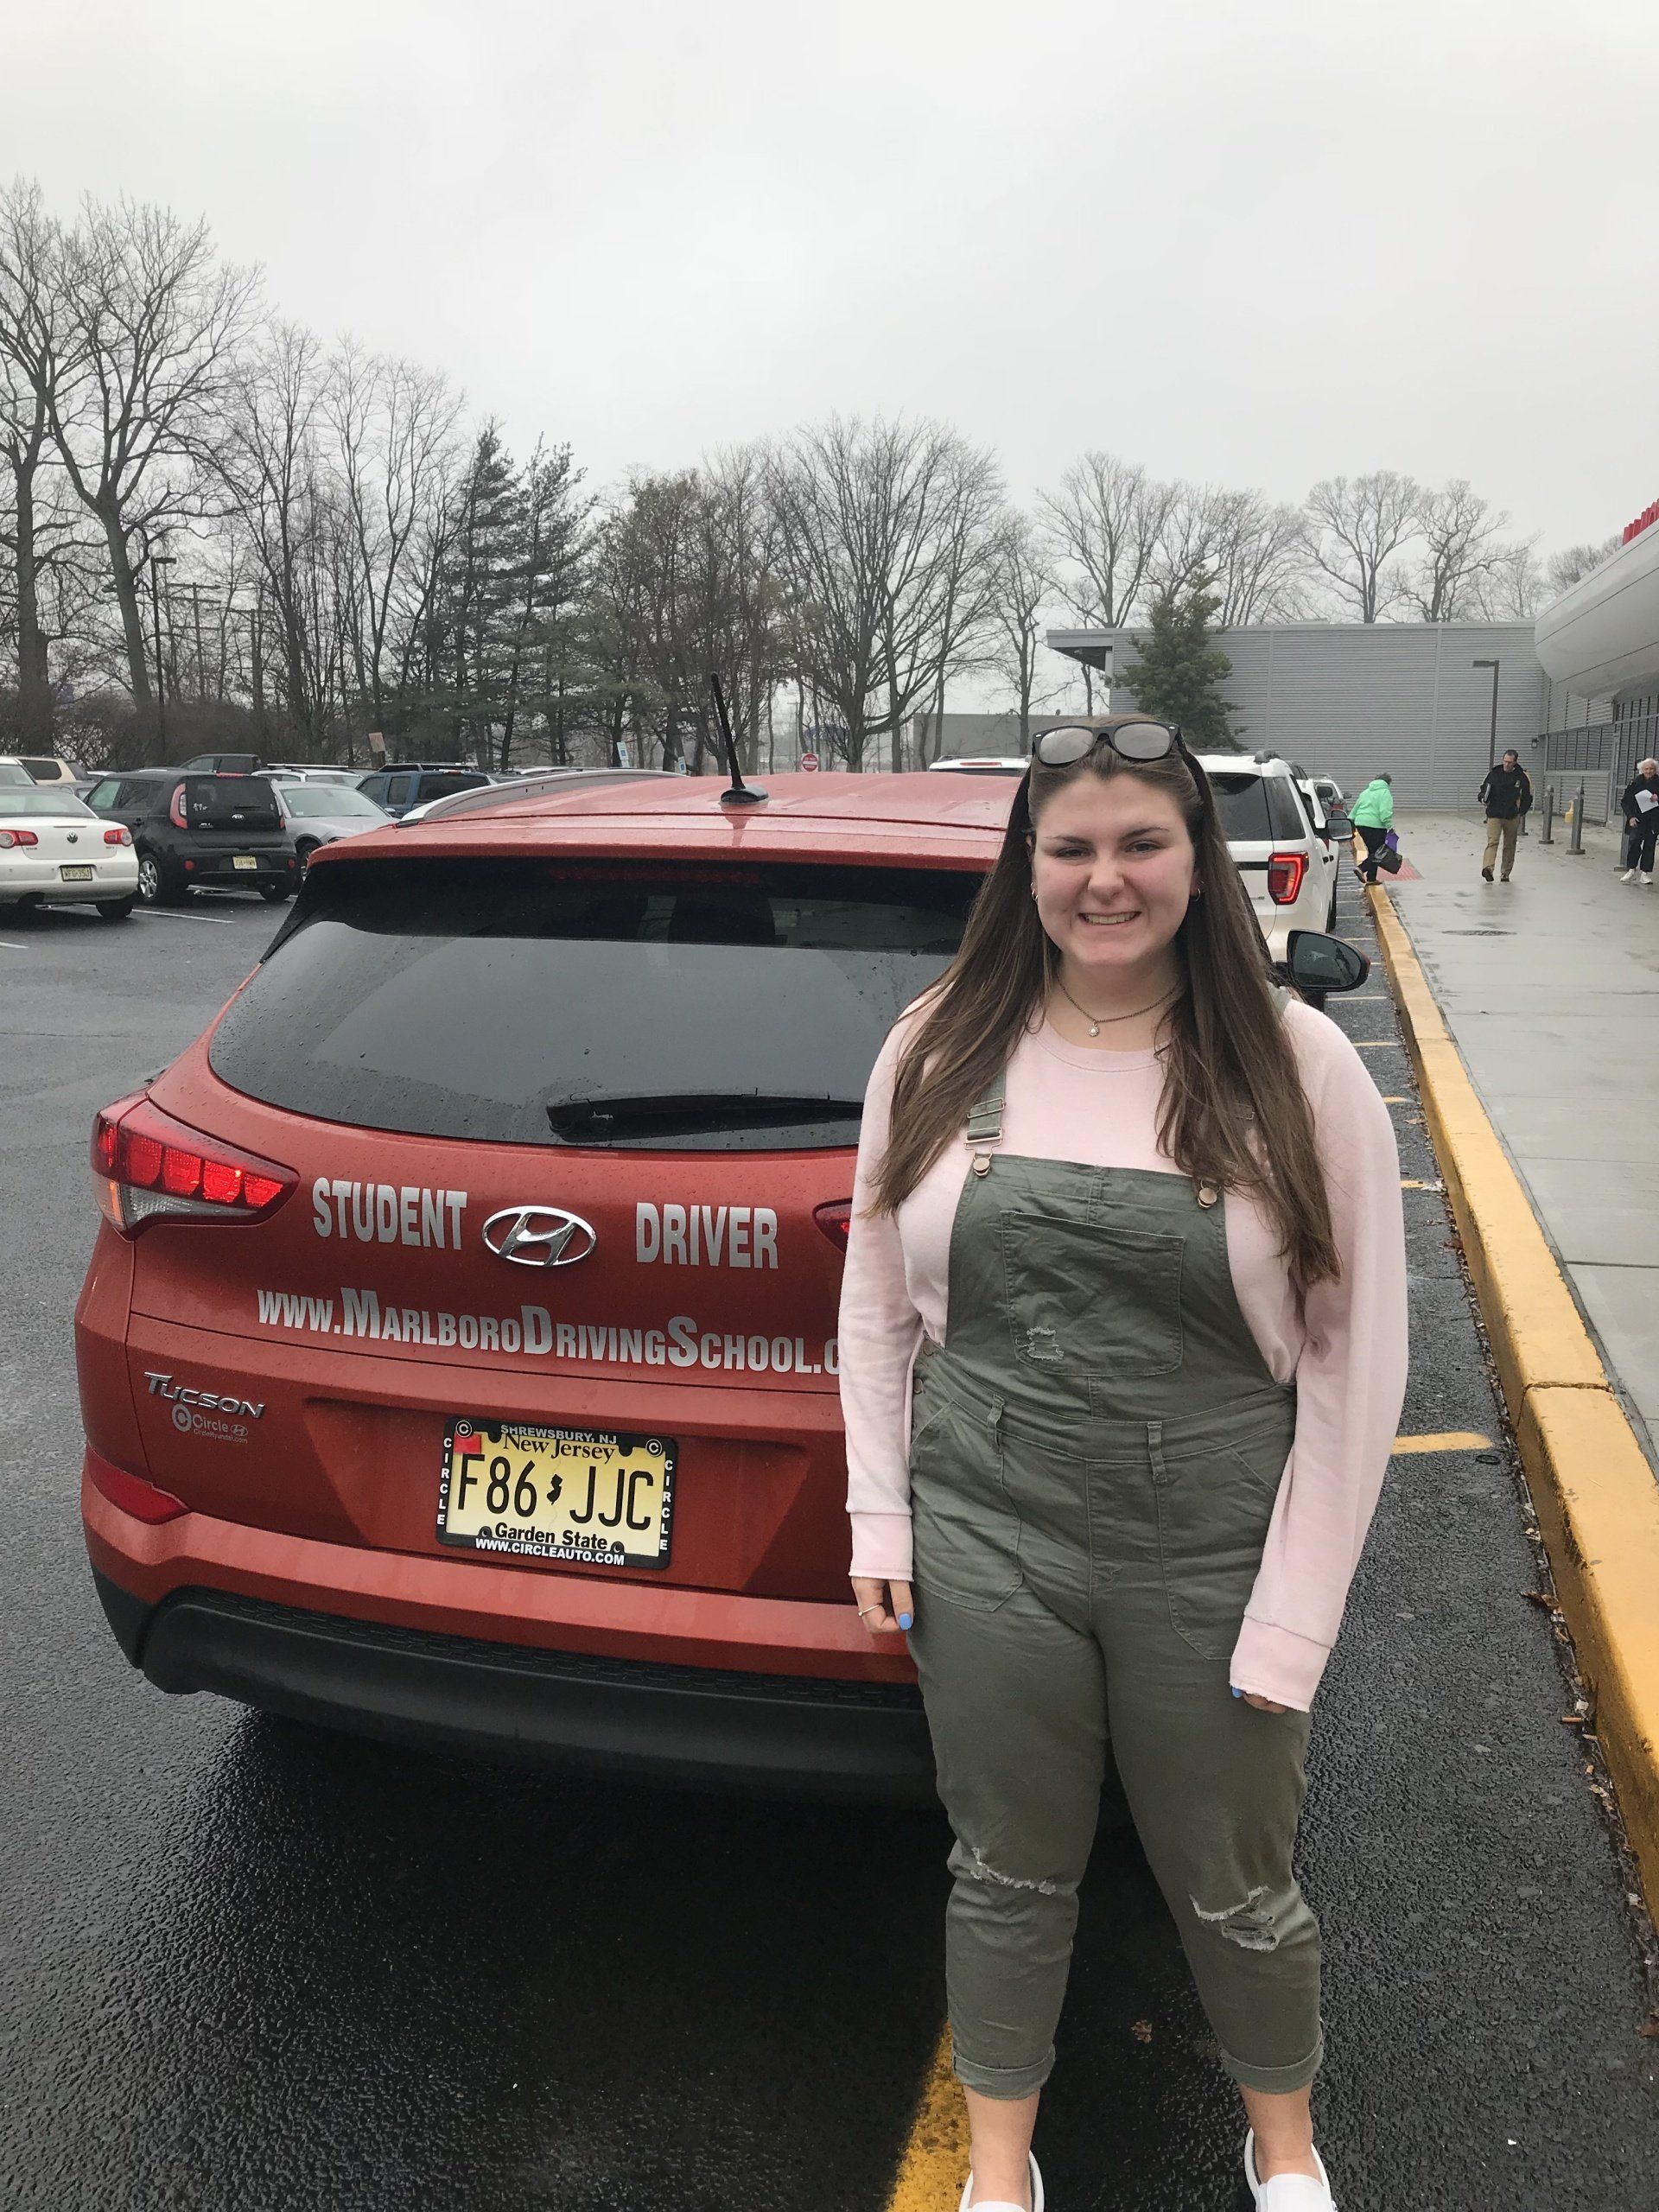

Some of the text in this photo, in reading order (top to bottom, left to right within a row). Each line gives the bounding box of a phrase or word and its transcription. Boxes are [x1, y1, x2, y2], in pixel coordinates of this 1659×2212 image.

[313, 1176, 467, 1250] STUDENT
[636, 1203, 779, 1269] DRIVER
[193, 1414, 229, 1433] Circle
[501, 1424, 617, 1445] SHREWSBURY, NJ
[503, 1434, 616, 1464] New Jersey
[436, 1437, 453, 1525] CIRCLE
[457, 1453, 654, 1530] F86 JJC
[659, 1460, 673, 1551] CIRCLE
[475, 1538, 625, 1566] WWW.CIRCLEAUTO.COM
[494, 1522, 607, 1550] Garden State
